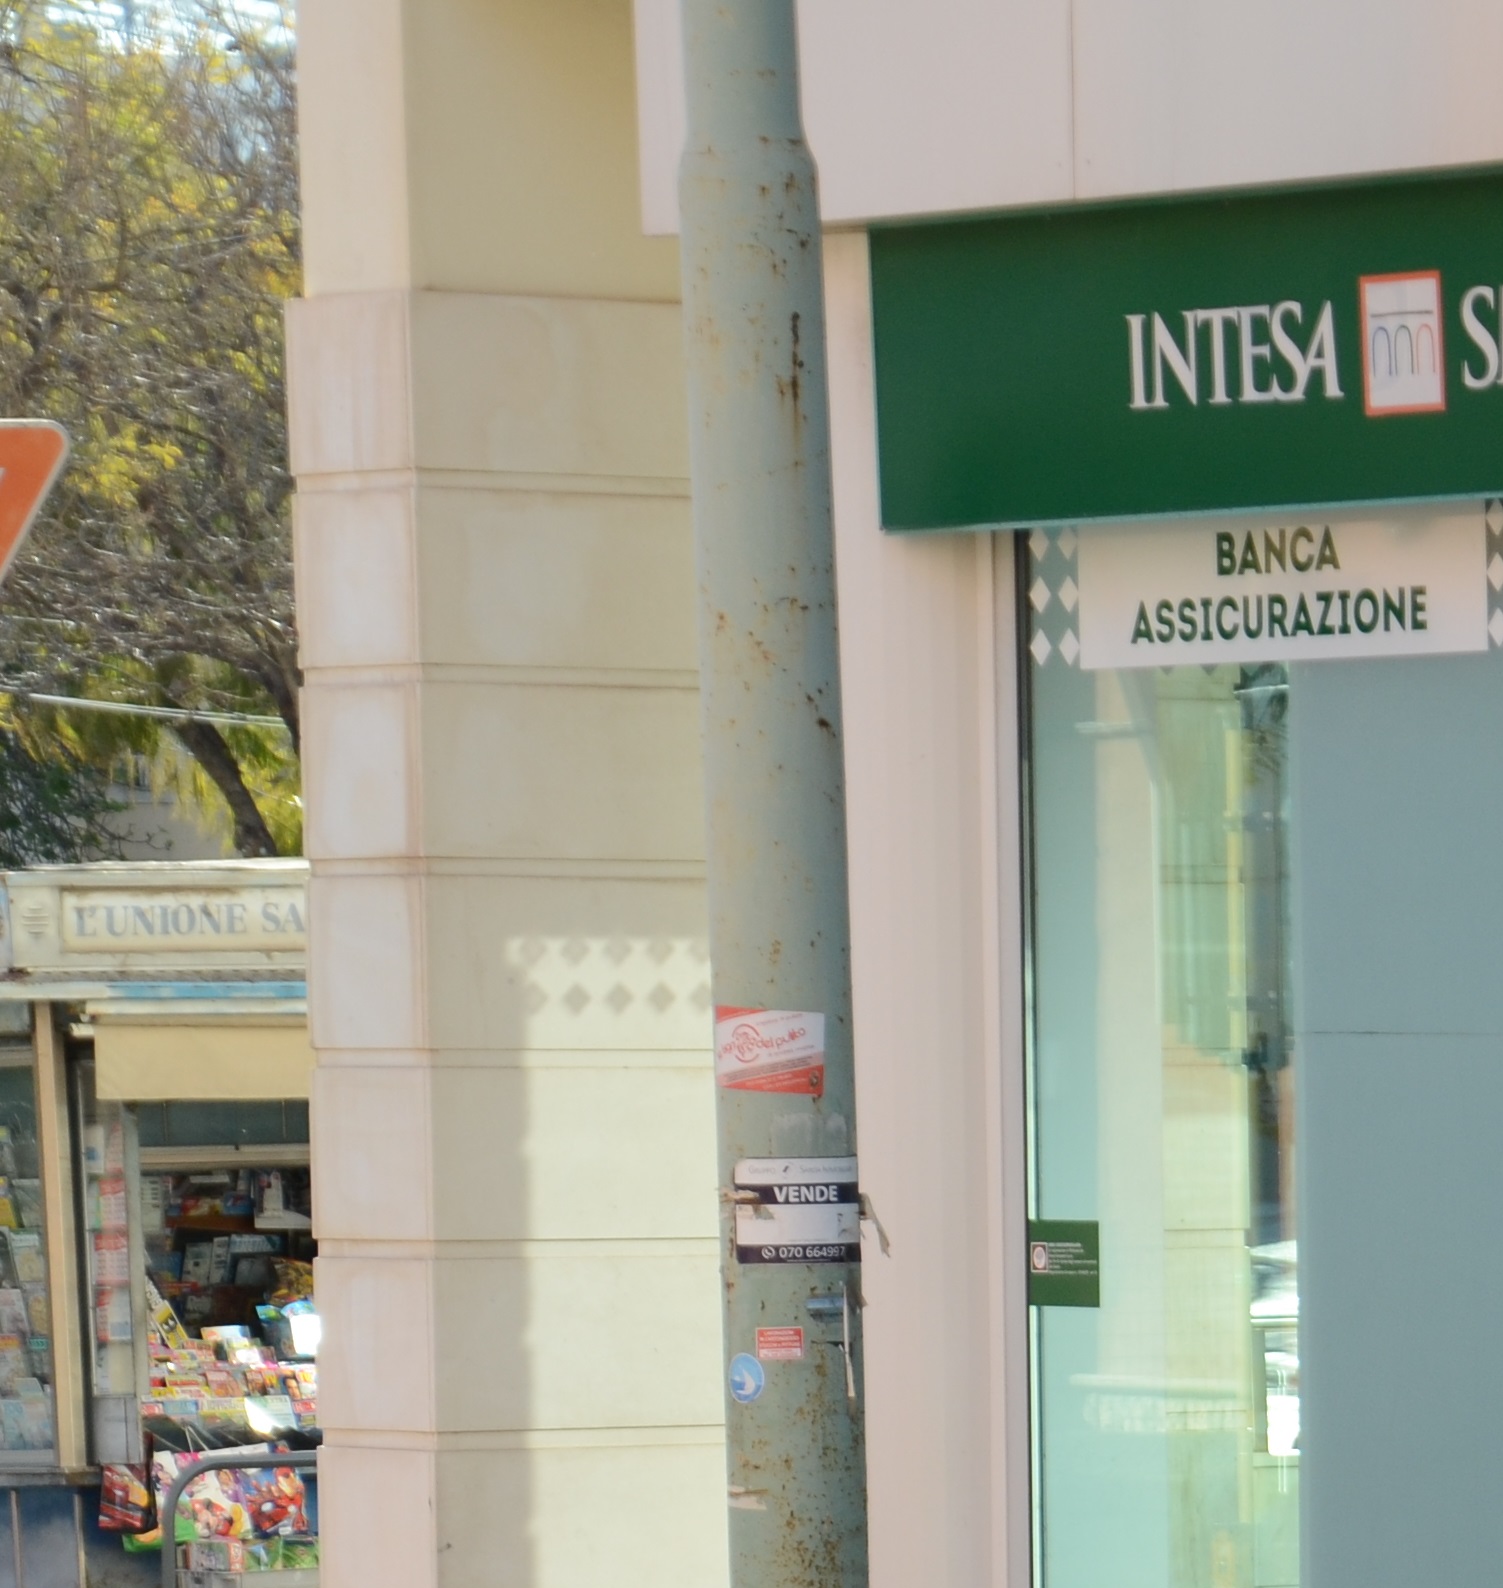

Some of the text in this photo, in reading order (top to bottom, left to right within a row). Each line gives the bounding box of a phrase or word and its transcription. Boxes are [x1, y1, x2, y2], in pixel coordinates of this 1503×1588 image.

[1124, 300, 1344, 409] INTESA
[1215, 526, 1341, 576] BANCA
[1130, 586, 1428, 646] ASSICURAZIONE
[74, 904, 246, 936] L'UNIONE
[773, 1186, 838, 1202] VENDE
[779, 1247, 802, 1258] 070
